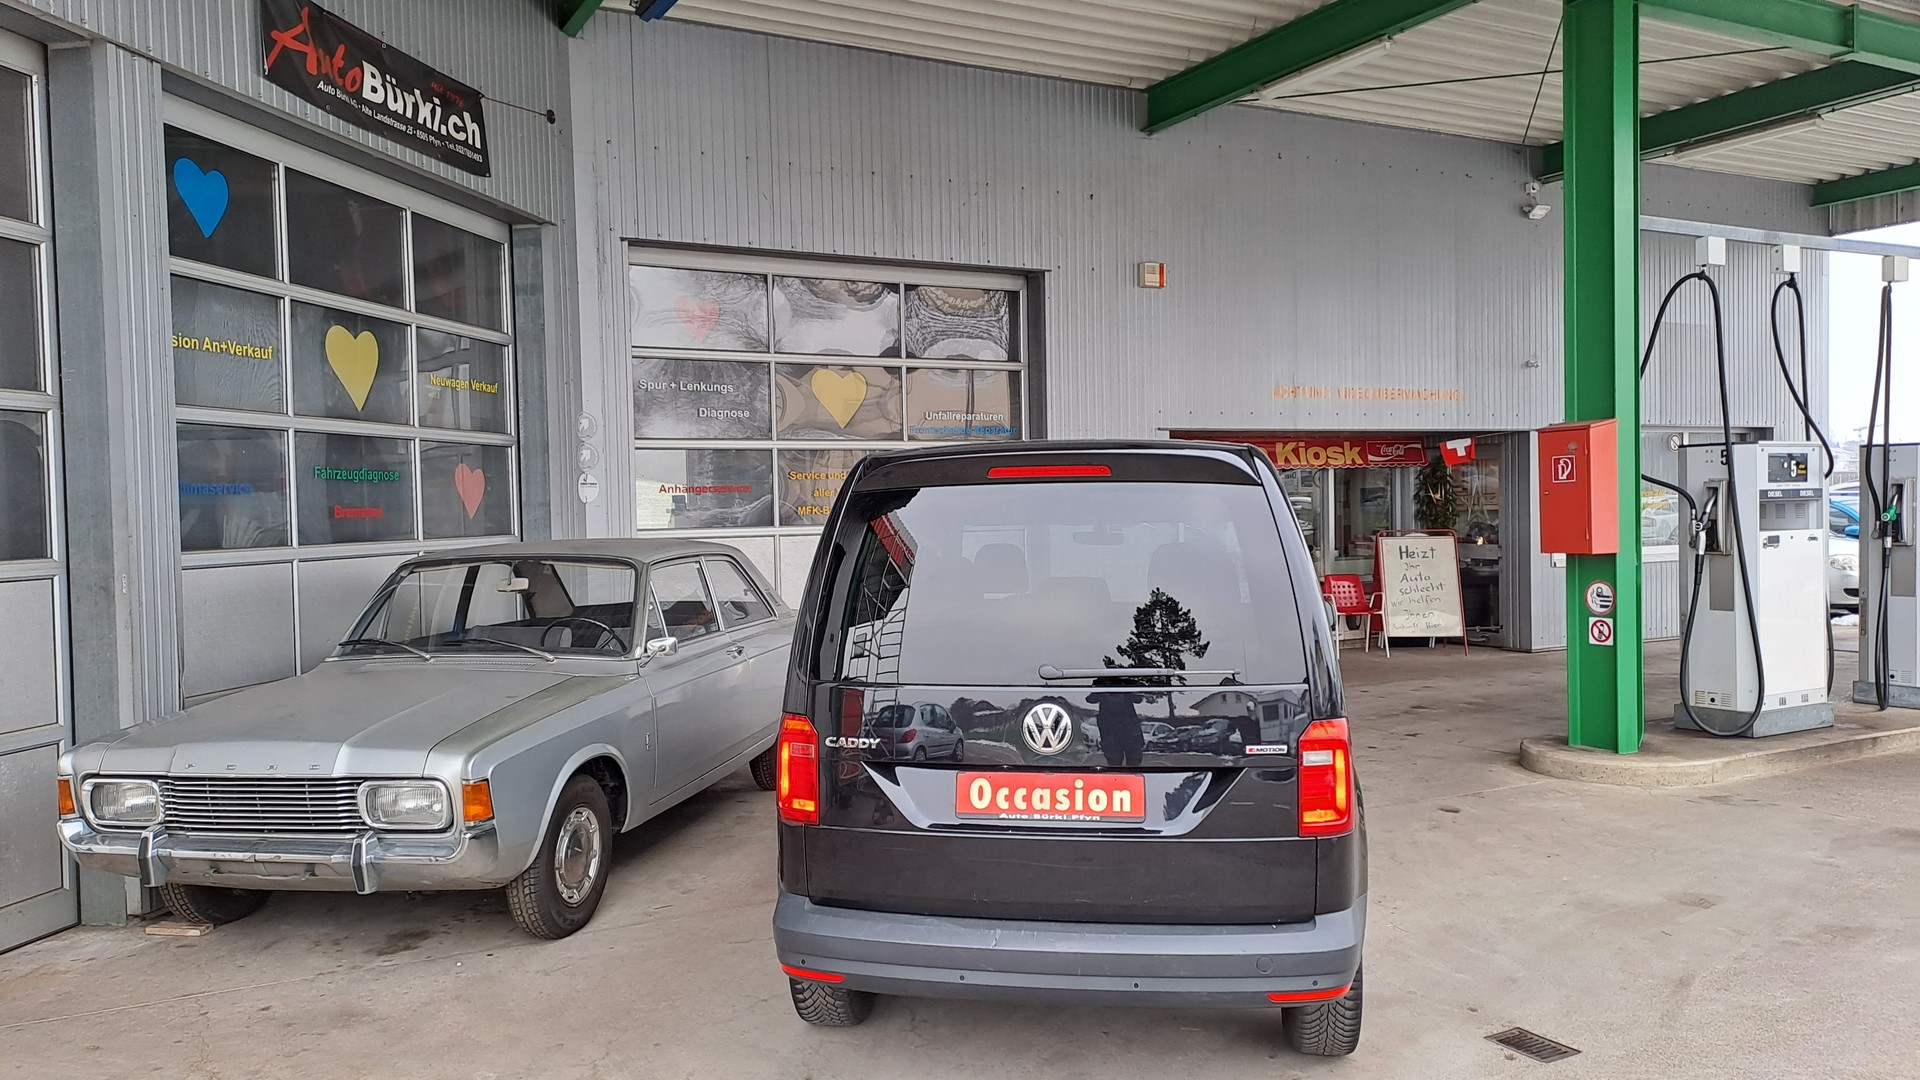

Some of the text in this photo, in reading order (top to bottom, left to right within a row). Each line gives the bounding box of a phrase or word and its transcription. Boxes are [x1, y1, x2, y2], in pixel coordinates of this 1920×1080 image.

[317, 80, 336, 95] Auto
[373, 109, 407, 132] Landstrasse
[406, 125, 414, 135] 25
[428, 134, 442, 147] Pfyn
[202, 336, 273, 360] An+Verkauf
[430, 372, 498, 394] Neuwagen Verkauf
[638, 379, 734, 394] Spur + Lenkungs
[698, 407, 750, 420] Diagnose
[924, 410, 1004, 423] Unfallreparaturen
[1275, 441, 1364, 466] Kiosk
[1720, 449, 1728, 466] 5
[314, 465, 400, 484] Fahrzeugdiagnose
[788, 470, 847, 480] Service und
[1790, 460, 1797, 478] 5
[812, 487, 833, 497] aller
[1767, 490, 1784, 498] DIESEL
[1399, 545, 1437, 560] Heizt
[1400, 572, 1431, 583] Auto
[1399, 582, 1446, 596] schlecht
[825, 736, 882, 749] CADDY
[969, 777, 1132, 813] Occasion
